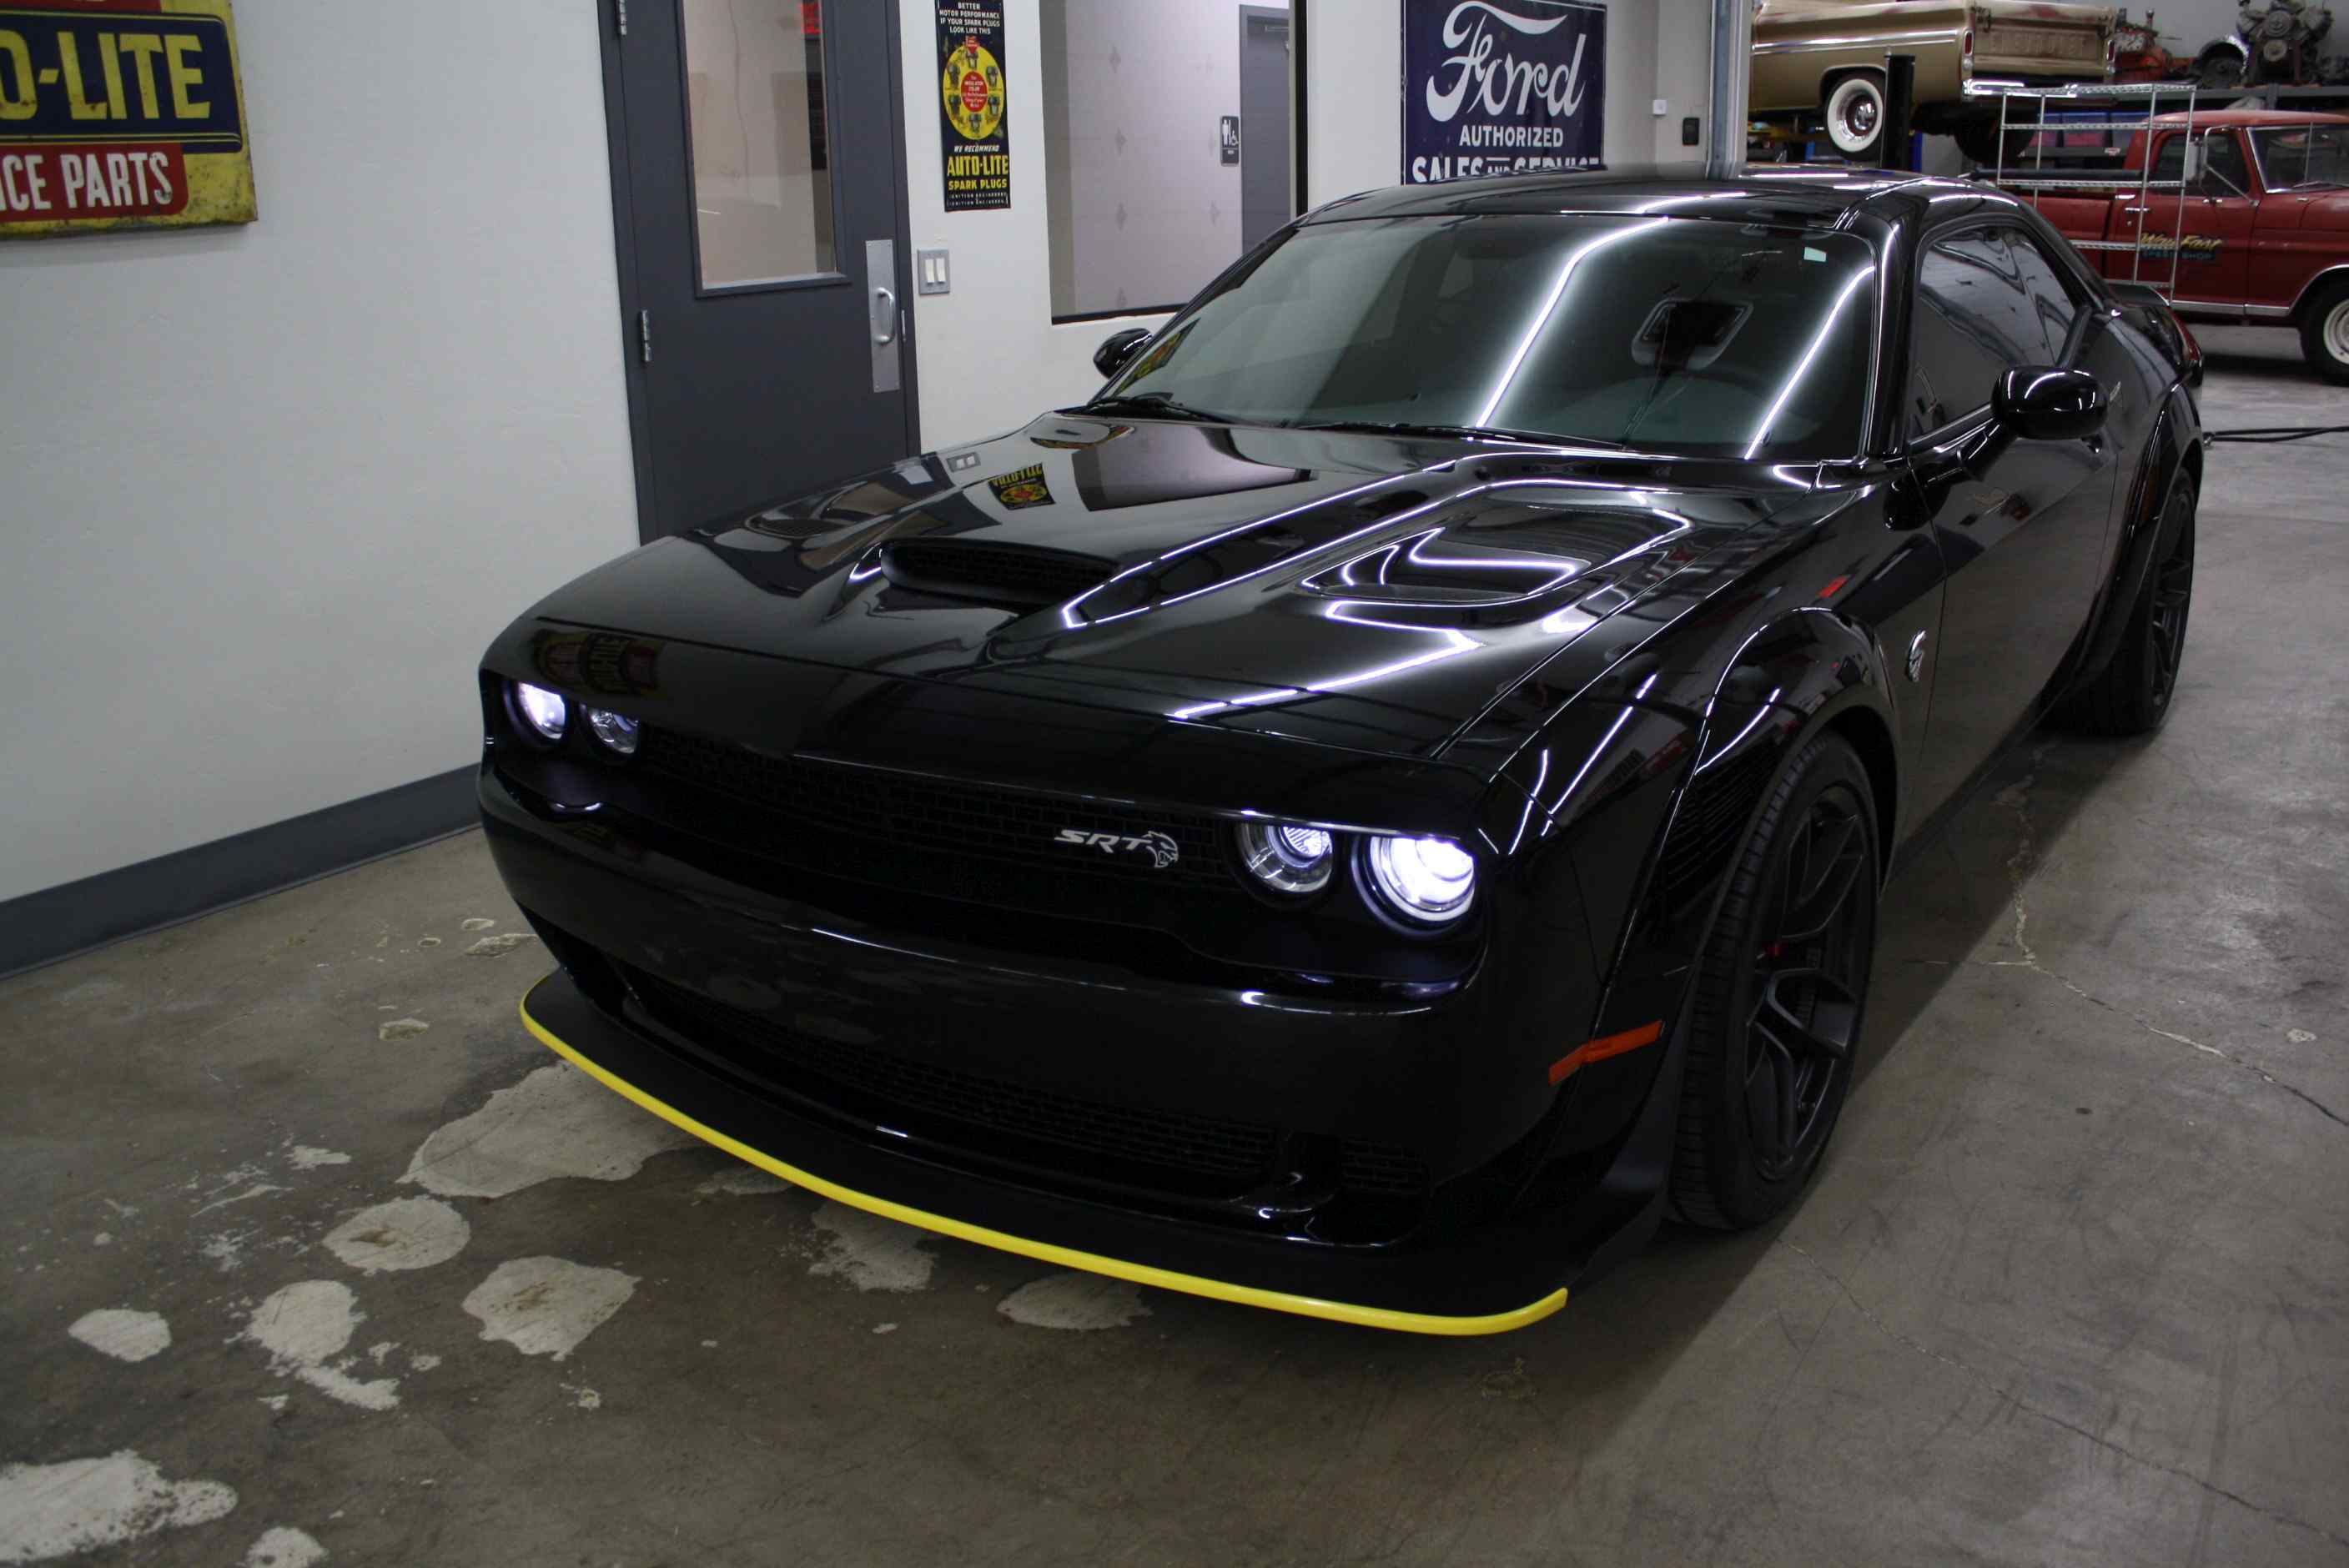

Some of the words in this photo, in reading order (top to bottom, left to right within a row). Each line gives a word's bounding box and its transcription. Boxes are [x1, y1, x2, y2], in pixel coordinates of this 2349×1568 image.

[960, 10, 1000, 19] PERFORMANCE
[1426, 1, 1587, 122] Ford
[1459, 125, 1563, 147] AUTHORIZED
[60, 152, 174, 208] PARTS
[948, 179, 977, 190] SPARK
[979, 178, 1008, 189] PLUGS
[1054, 830, 1153, 853] SRT
